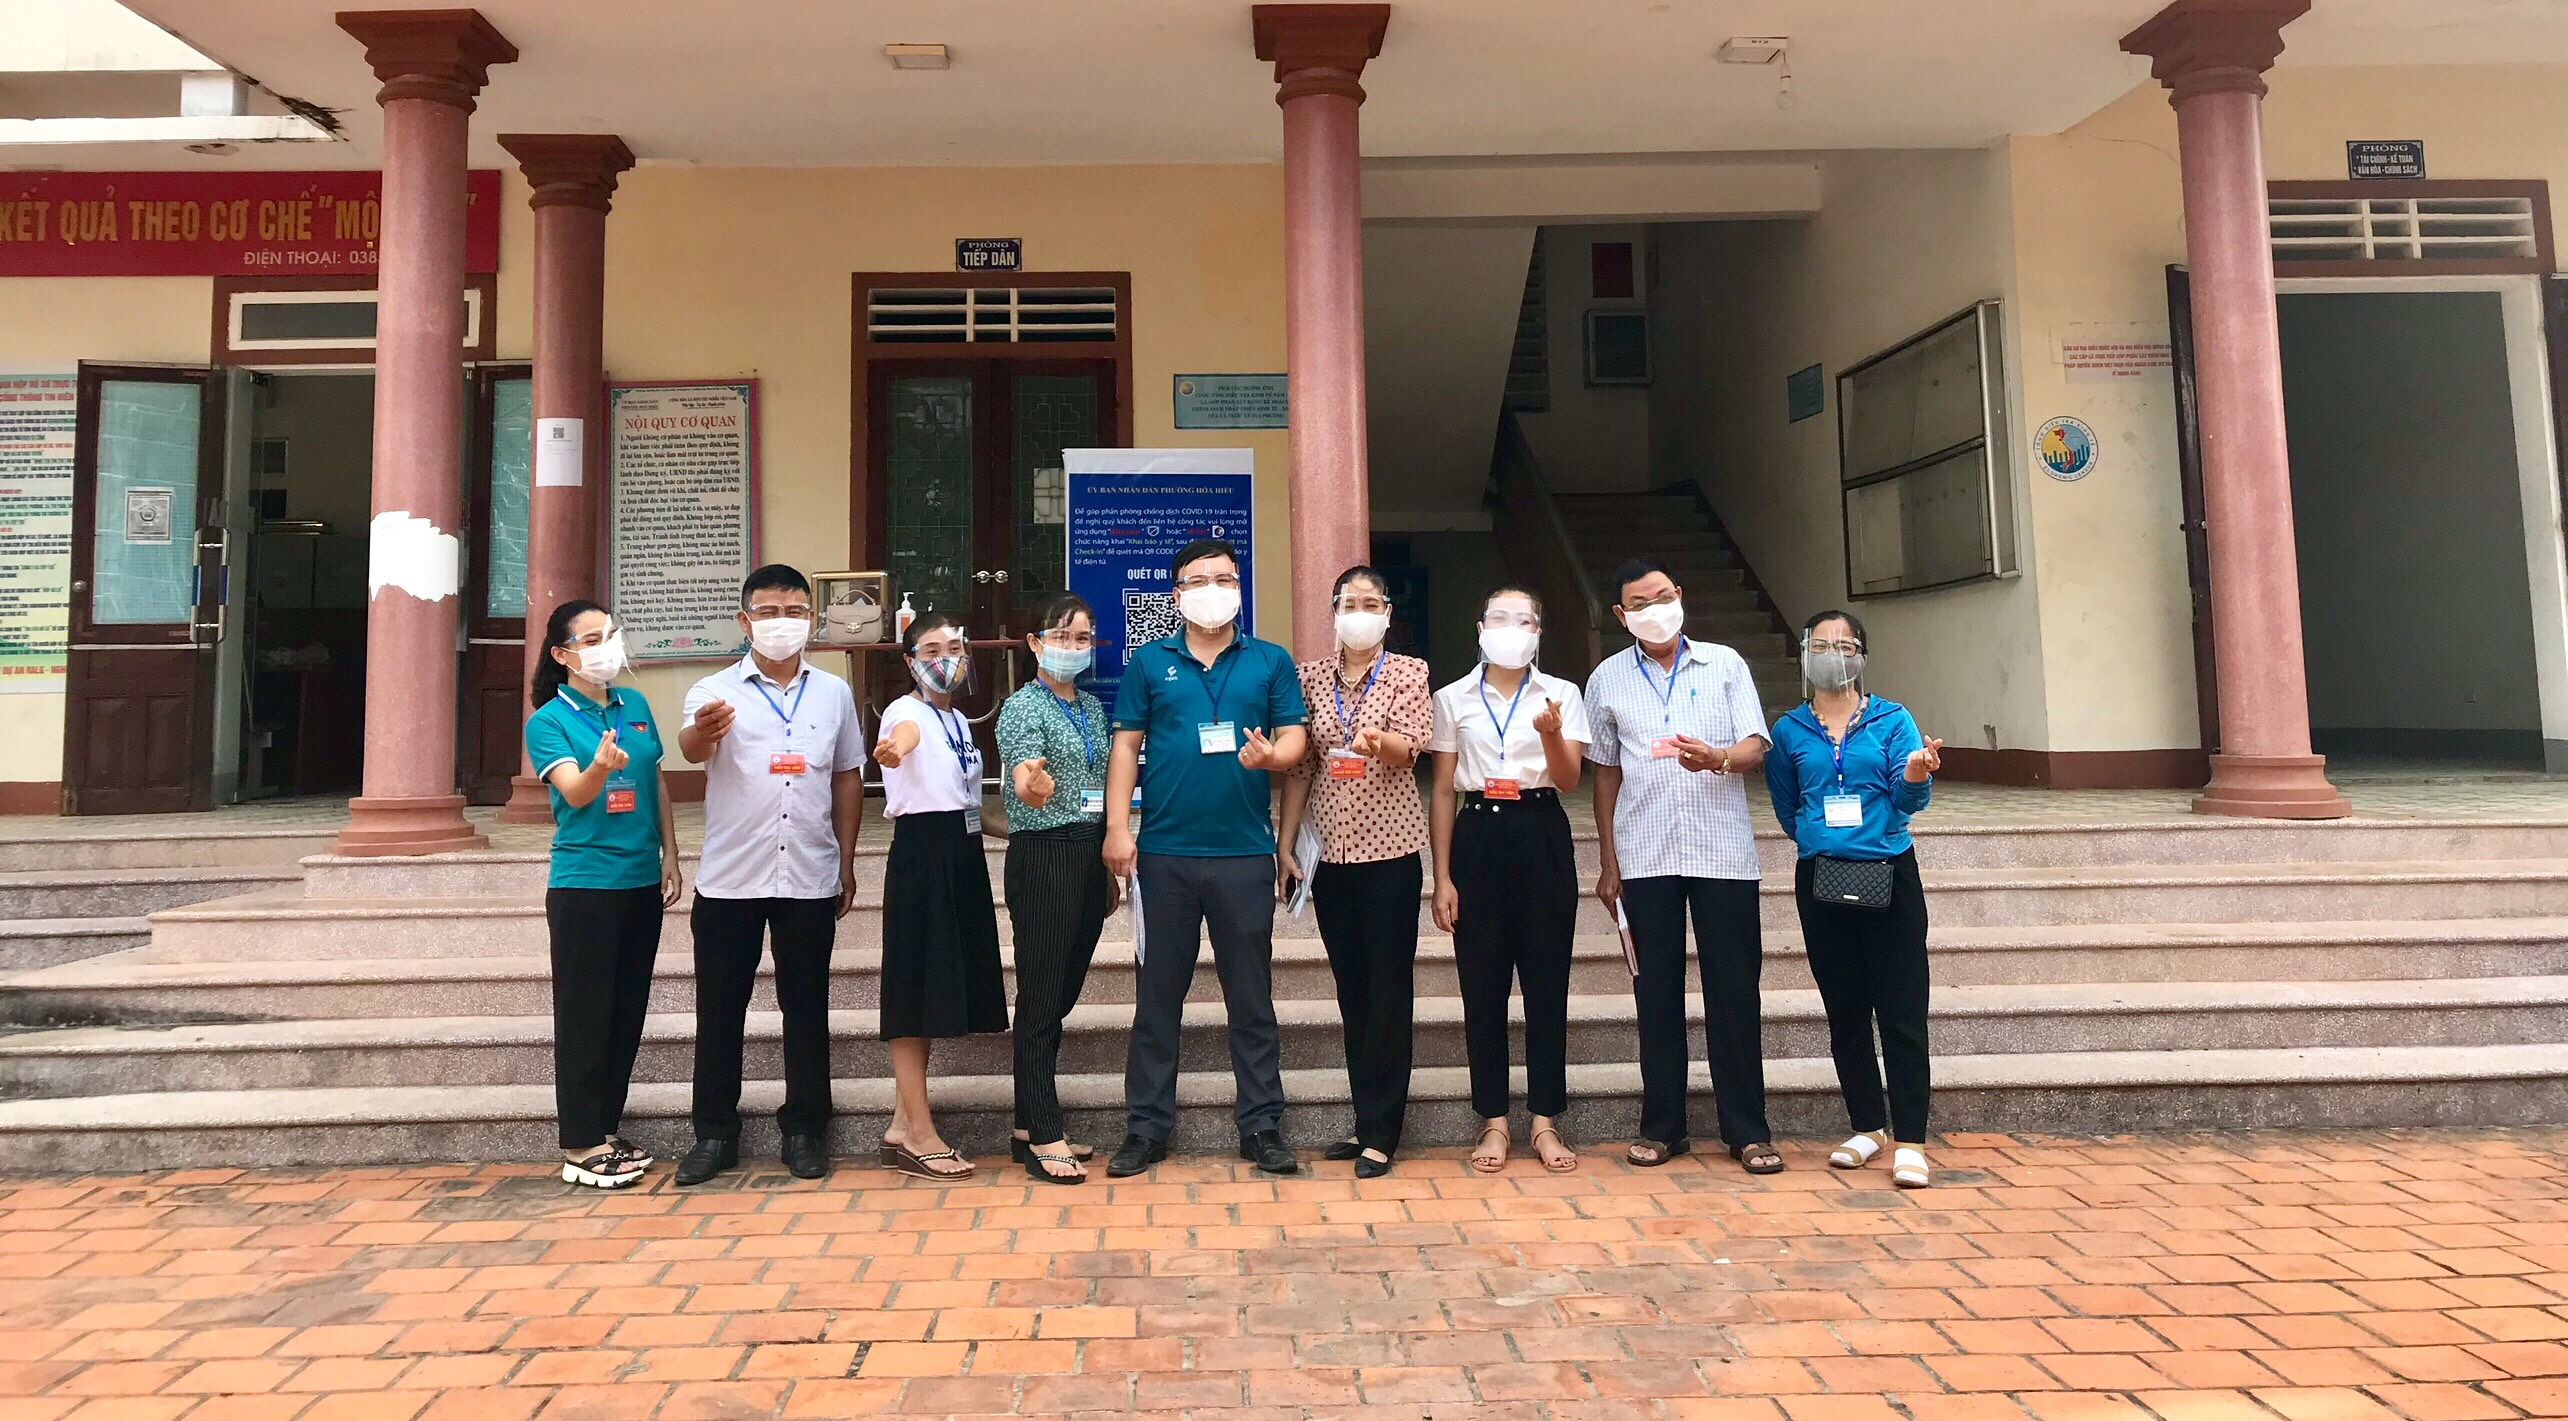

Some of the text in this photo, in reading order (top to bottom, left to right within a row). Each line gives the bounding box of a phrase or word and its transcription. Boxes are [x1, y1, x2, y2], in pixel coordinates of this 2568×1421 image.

[2362, 144, 2408, 152] PHÒNG
[59, 184, 118, 245] QUẢ
[128, 200, 200, 241] THEO
[209, 199, 250, 242] CƠ
[258, 184, 314, 241] CHẾ
[244, 250, 380, 268] ĐIỆN THOẠI: 038
[963, 248, 1015, 266] TIẾP DÂN
[626, 415, 736, 432] NỘI QUY CƠ QUAN
[1089, 528, 1107, 536] dụng
[1127, 566, 1151, 580] QUÉT
[1154, 569, 1167, 580] QR
